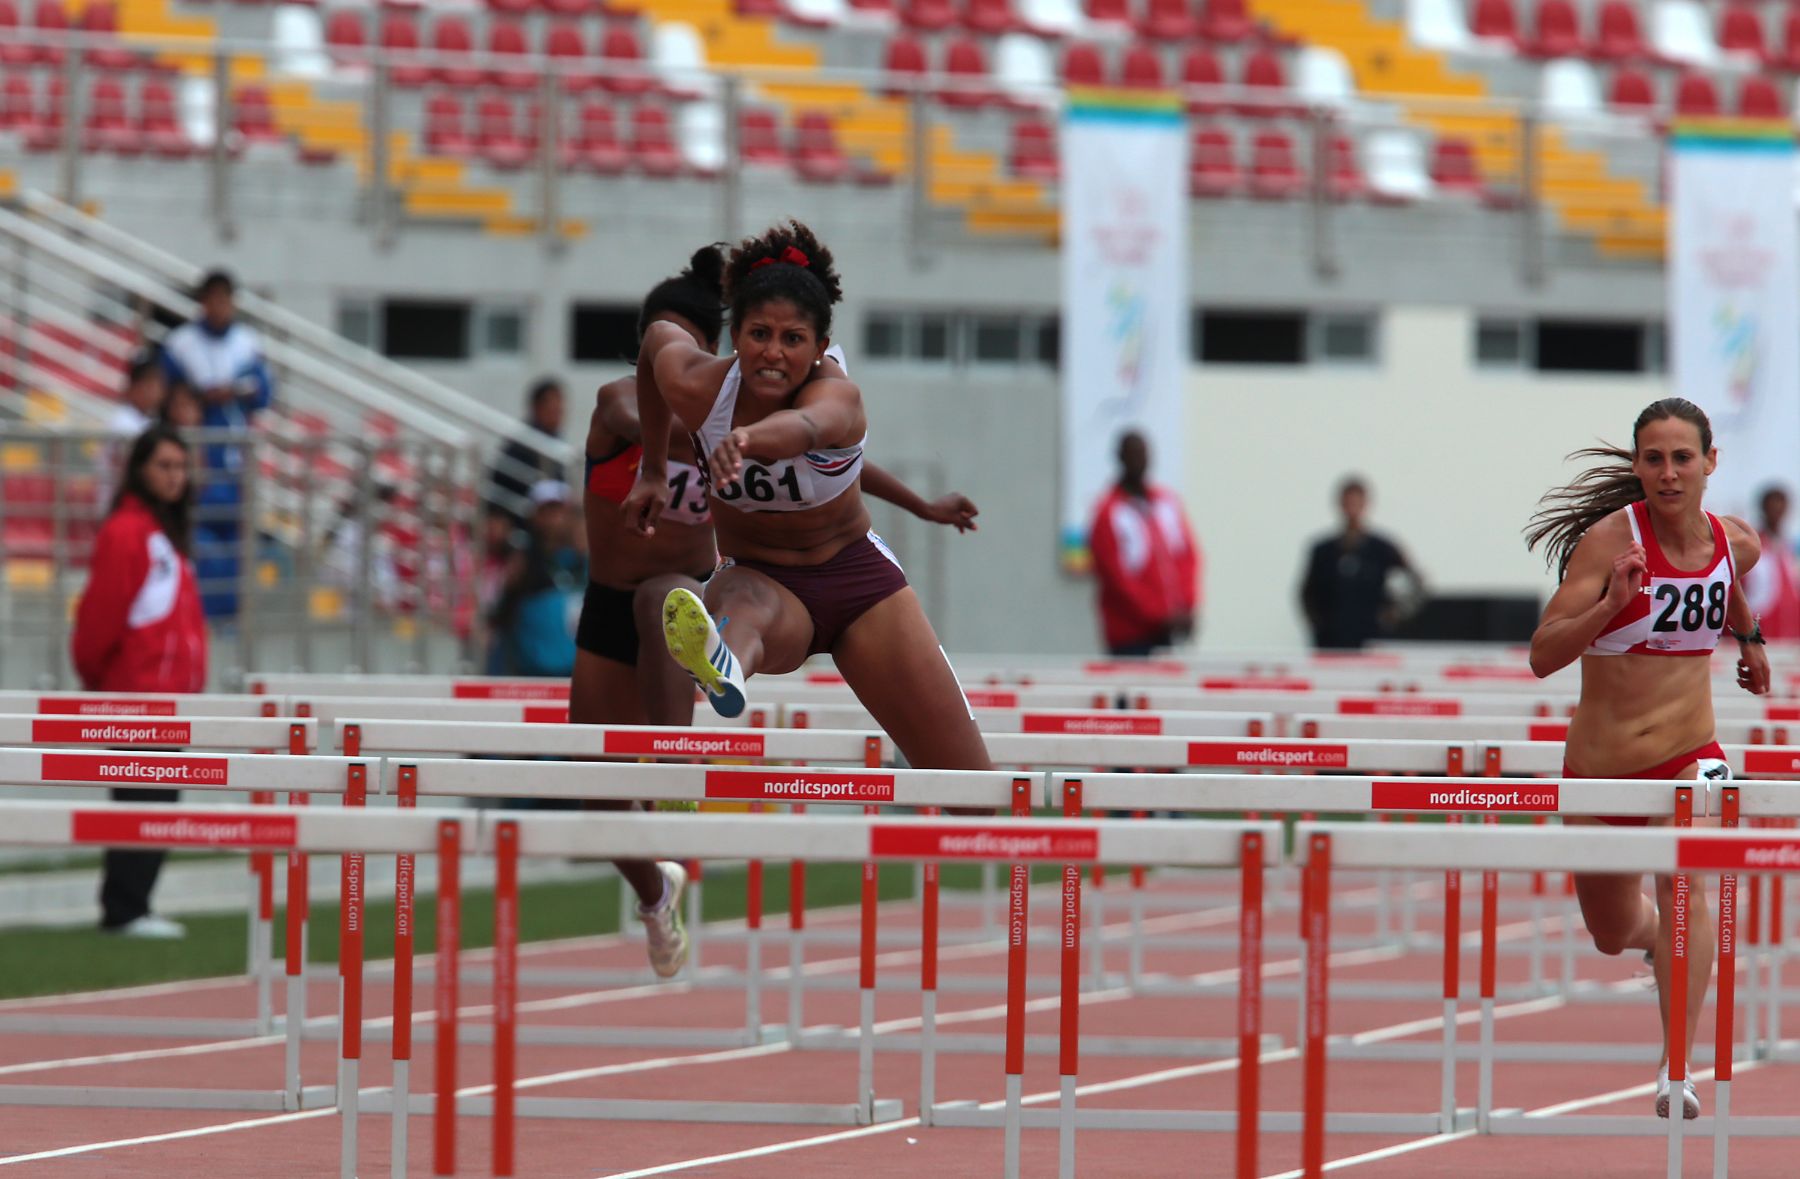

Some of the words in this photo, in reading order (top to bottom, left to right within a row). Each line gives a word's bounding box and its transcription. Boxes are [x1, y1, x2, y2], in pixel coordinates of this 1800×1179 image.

[1652, 581, 1725, 632] 288
[81, 725, 188, 741] nordicsport.com
[653, 736, 762, 754] nordicsport.com
[1237, 748, 1346, 765] nordicsport.com
[99, 762, 224, 780] nordicsport.com
[764, 779, 890, 798] nordicsport.com
[1430, 789, 1555, 808] nordicsport.com
[347, 852, 362, 931] dicsport.com
[1009, 865, 1026, 946] dicsport.com
[1720, 875, 1735, 953] dicsport.com
